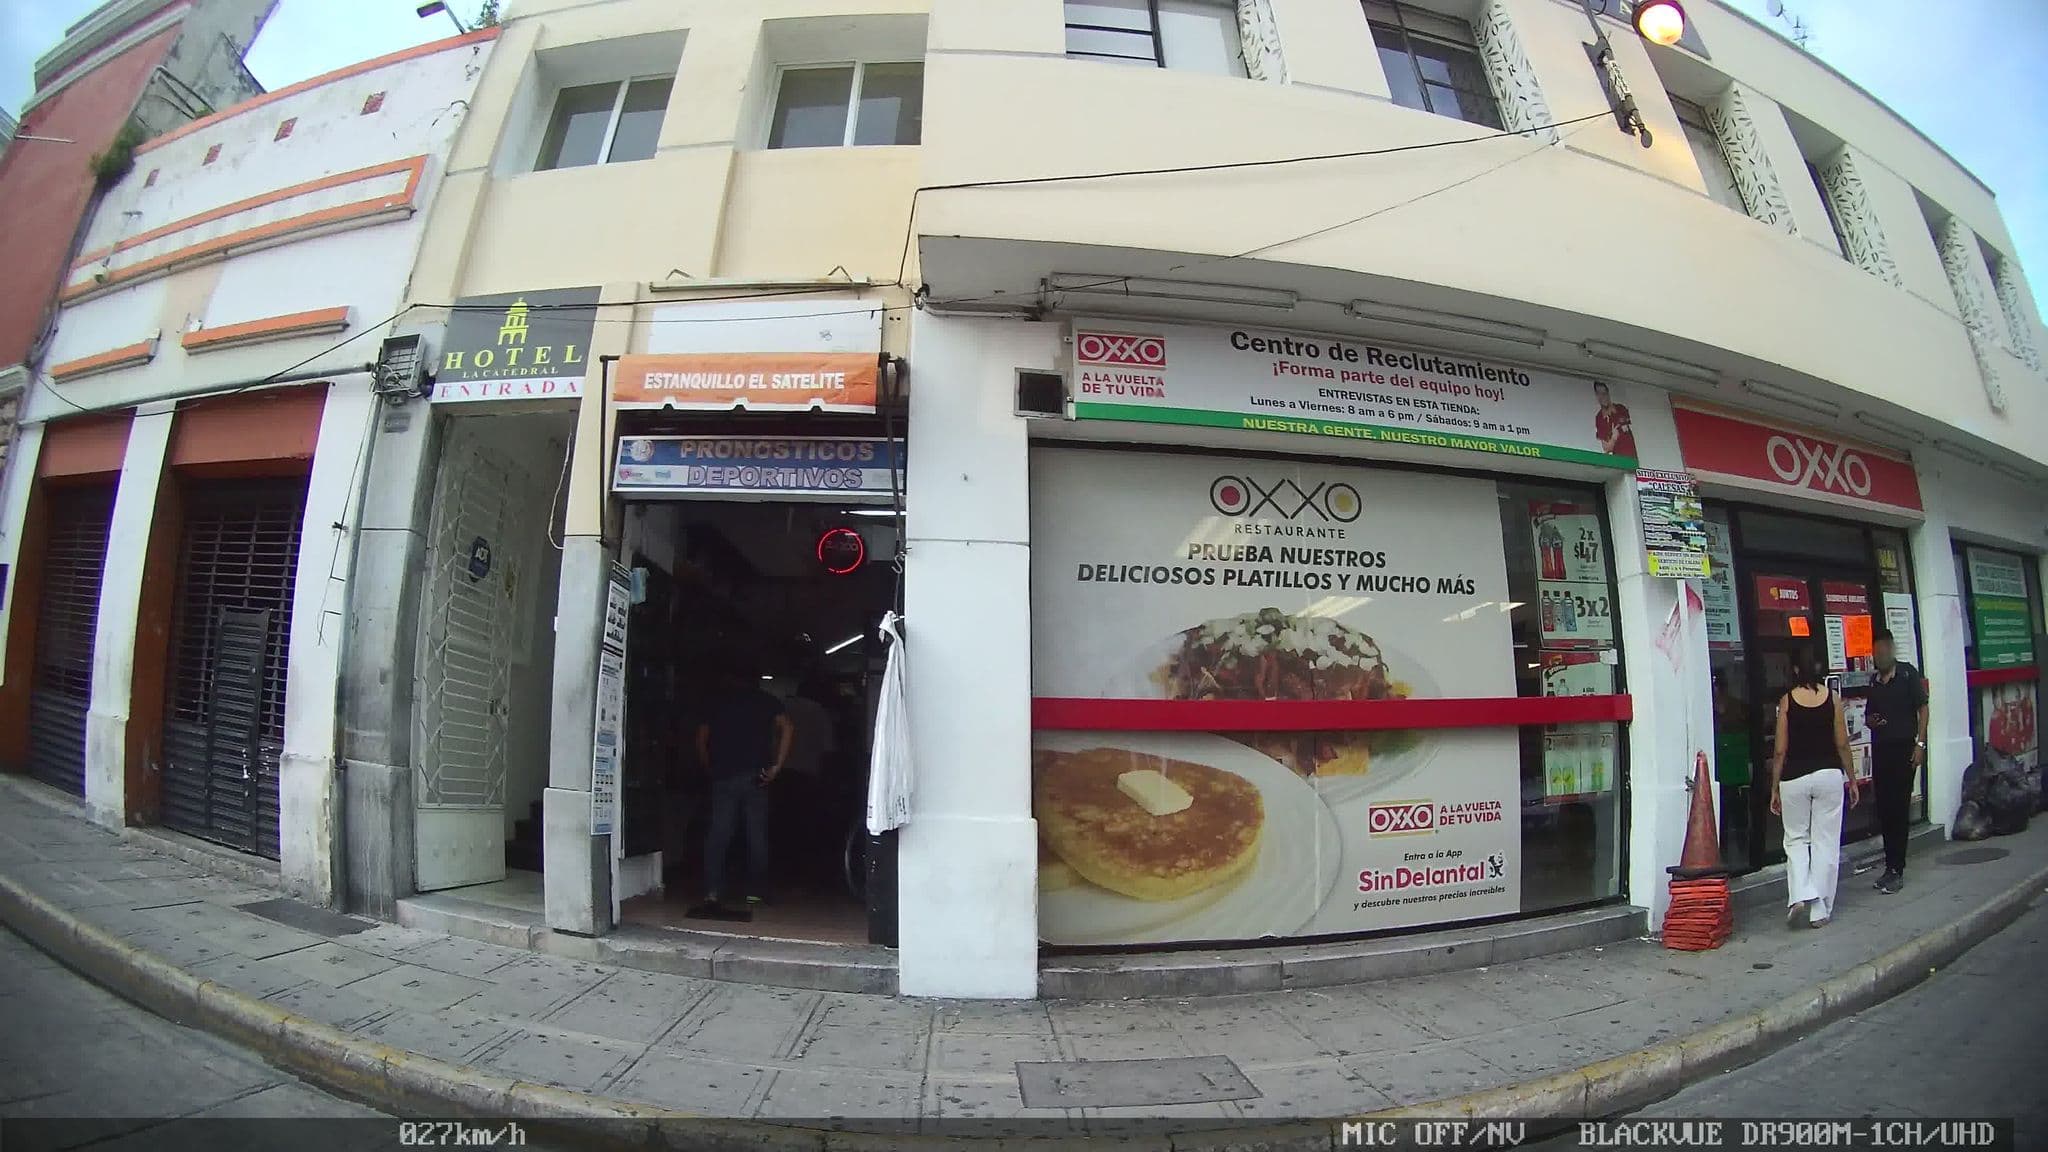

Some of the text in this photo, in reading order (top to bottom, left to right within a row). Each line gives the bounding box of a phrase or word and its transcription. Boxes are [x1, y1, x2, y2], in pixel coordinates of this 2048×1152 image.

[444, 345, 583, 370] HOTEL
[1080, 334, 1165, 362] OXXO
[1231, 331, 1530, 387] Centro de Reclutamiento
[463, 366, 559, 379] LA CATEDRAL
[644, 372, 845, 390] ESTANQUILLO EL SATELITE
[1082, 372, 1165, 386] A LA VUELTA
[1272, 361, 1505, 402] ¡Forma parte del equipo hoy!
[441, 380, 577, 398] ENTRADA
[1082, 383, 1165, 398] DE TU VIDA
[1318, 388, 1481, 415] ENTREVISTAS EN ESTA TIENDA:
[1250, 396, 1531, 435] Lunes a Viernes: 8 am a 6 pm / Sábados: 9 am a 1 pm
[1242, 418, 1321, 434] NUESTRA
[1380, 430, 1447, 447] NUESTRO
[1450, 437, 1498, 453] MAYOR
[1499, 443, 1541, 457] VALOR
[680, 440, 875, 461] PRONOSTICOS
[687, 466, 864, 489] DEPORTIVOS
[1766, 435, 1871, 496] OXXO
[1210, 475, 1362, 523] OXXO
[1235, 523, 1346, 540] RESTAURANTE
[1187, 542, 1386, 569] PRUEBA NUESTROS
[1077, 564, 1475, 596] DELICIOSOS PLATILLOS Y MUCHO MÁS
[1575, 596, 1610, 618] 3x2
[1370, 805, 1433, 832] OXXO
[1439, 800, 1502, 814] A LA VUELTA
[1439, 811, 1502, 826] DE TU VIDA
[1404, 852, 1426, 861] Entra
[1446, 850, 1463, 859] App
[1359, 861, 1485, 892] SinDelantal
[1353, 902, 1360, 911] y
[1361, 897, 1401, 909] descubre
[1402, 894, 1437, 905] nuestros
[1438, 890, 1467, 902] precios
